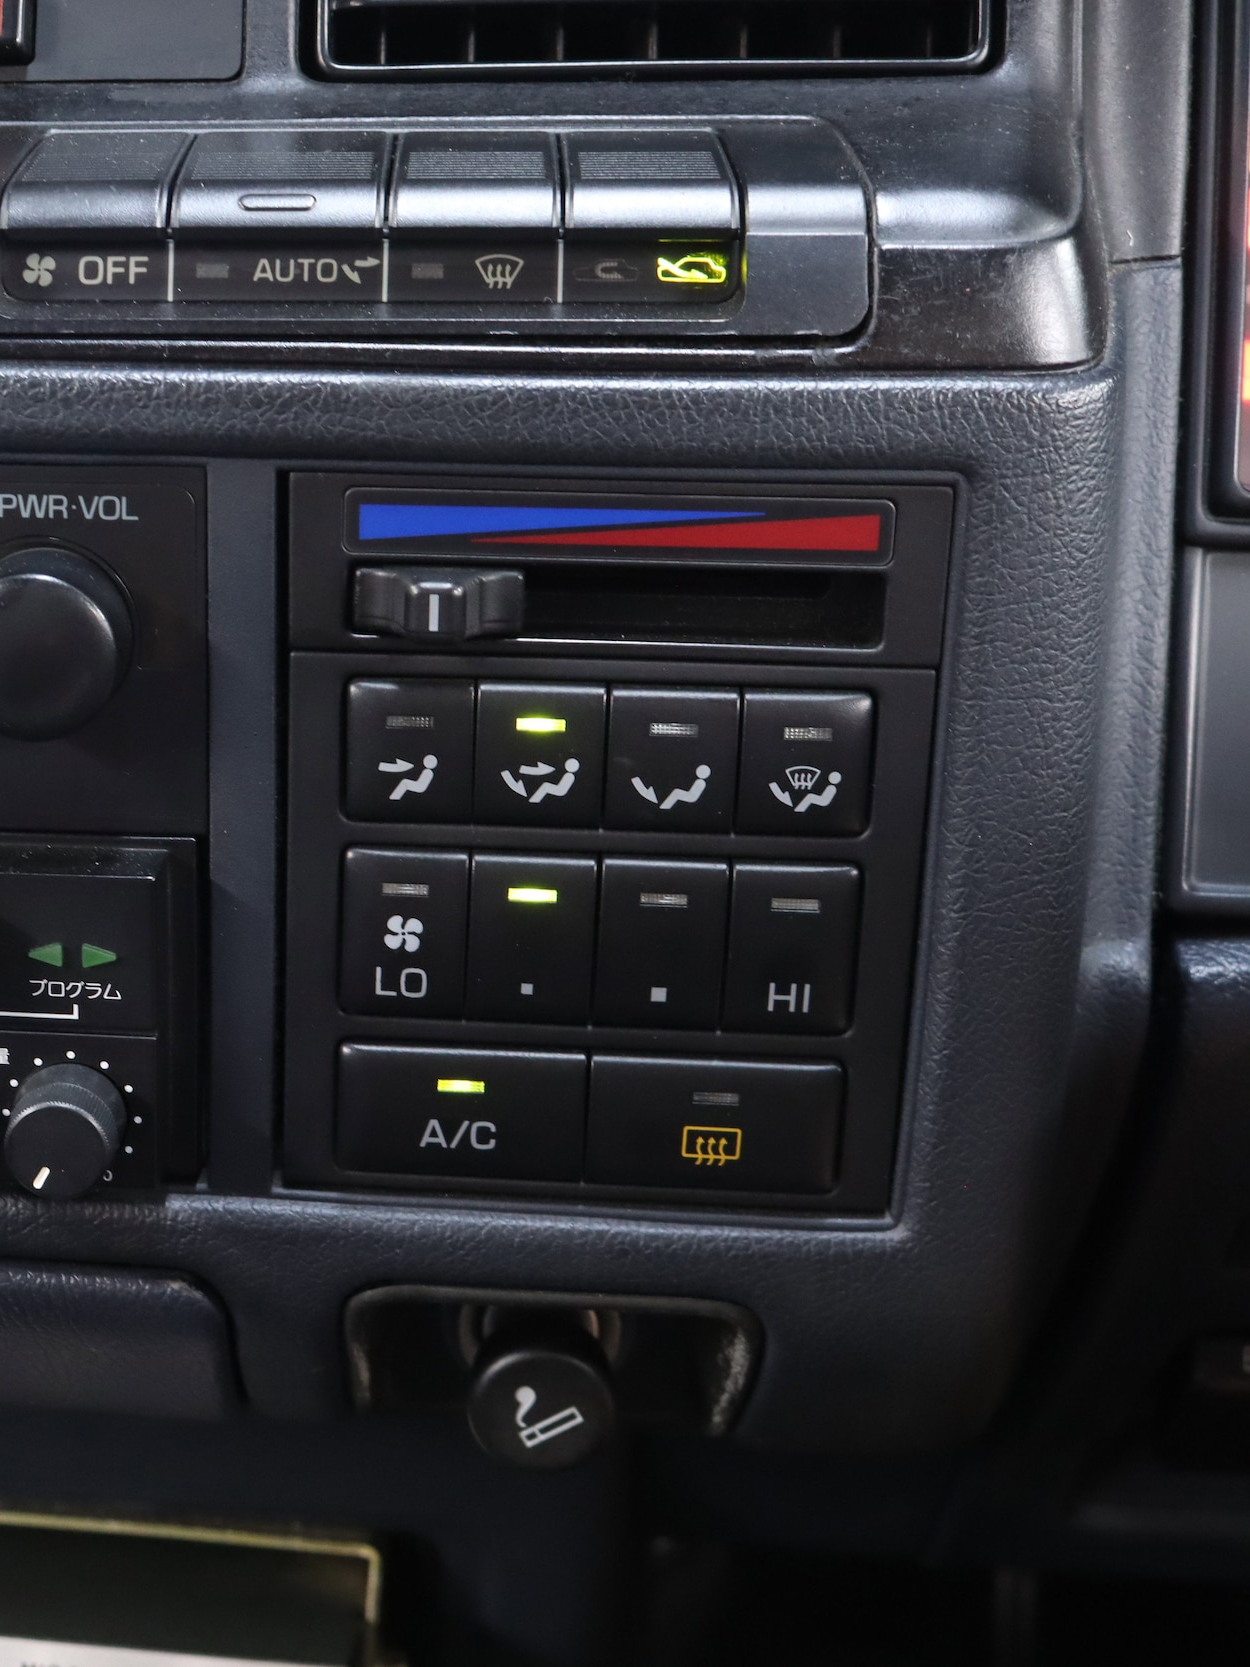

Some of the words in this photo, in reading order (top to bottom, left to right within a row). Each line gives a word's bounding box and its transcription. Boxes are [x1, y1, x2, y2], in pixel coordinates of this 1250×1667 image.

[77, 255, 150, 286] OFF
[252, 257, 339, 284] AUTO
[28, 979, 123, 1001] プログラム
[374, 966, 428, 999] LO
[767, 982, 811, 1013] HI
[419, 1120, 498, 1150] A/C
